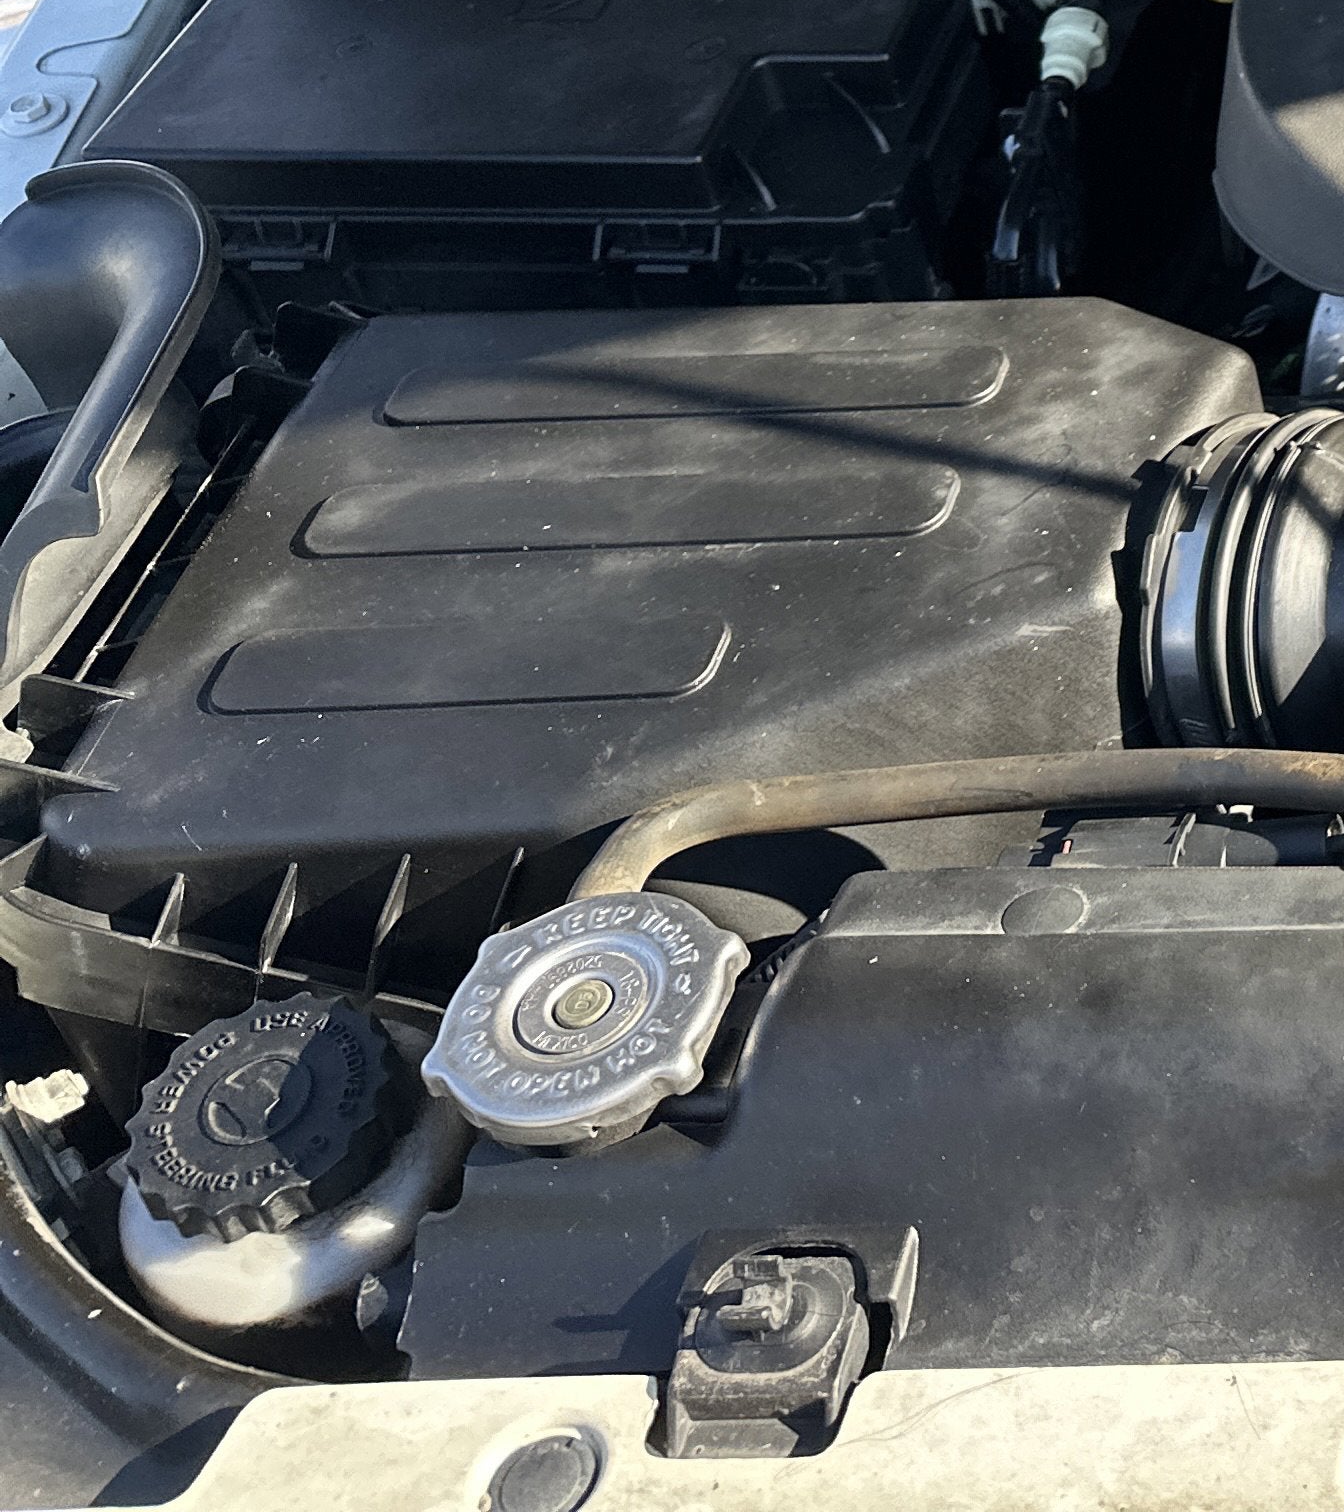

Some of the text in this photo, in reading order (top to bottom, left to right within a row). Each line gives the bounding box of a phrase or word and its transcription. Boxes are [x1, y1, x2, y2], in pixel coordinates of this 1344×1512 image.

[535, 903, 700, 967] KEEP TIGHT
[250, 1010, 309, 1034] USE
[461, 983, 502, 1023] DO
[460, 1029, 508, 1080] NOT
[606, 1018, 672, 1073] HOT
[150, 1030, 238, 1115] POWER
[501, 1065, 602, 1096] OPEN
[146, 1120, 240, 1193] STEERING
